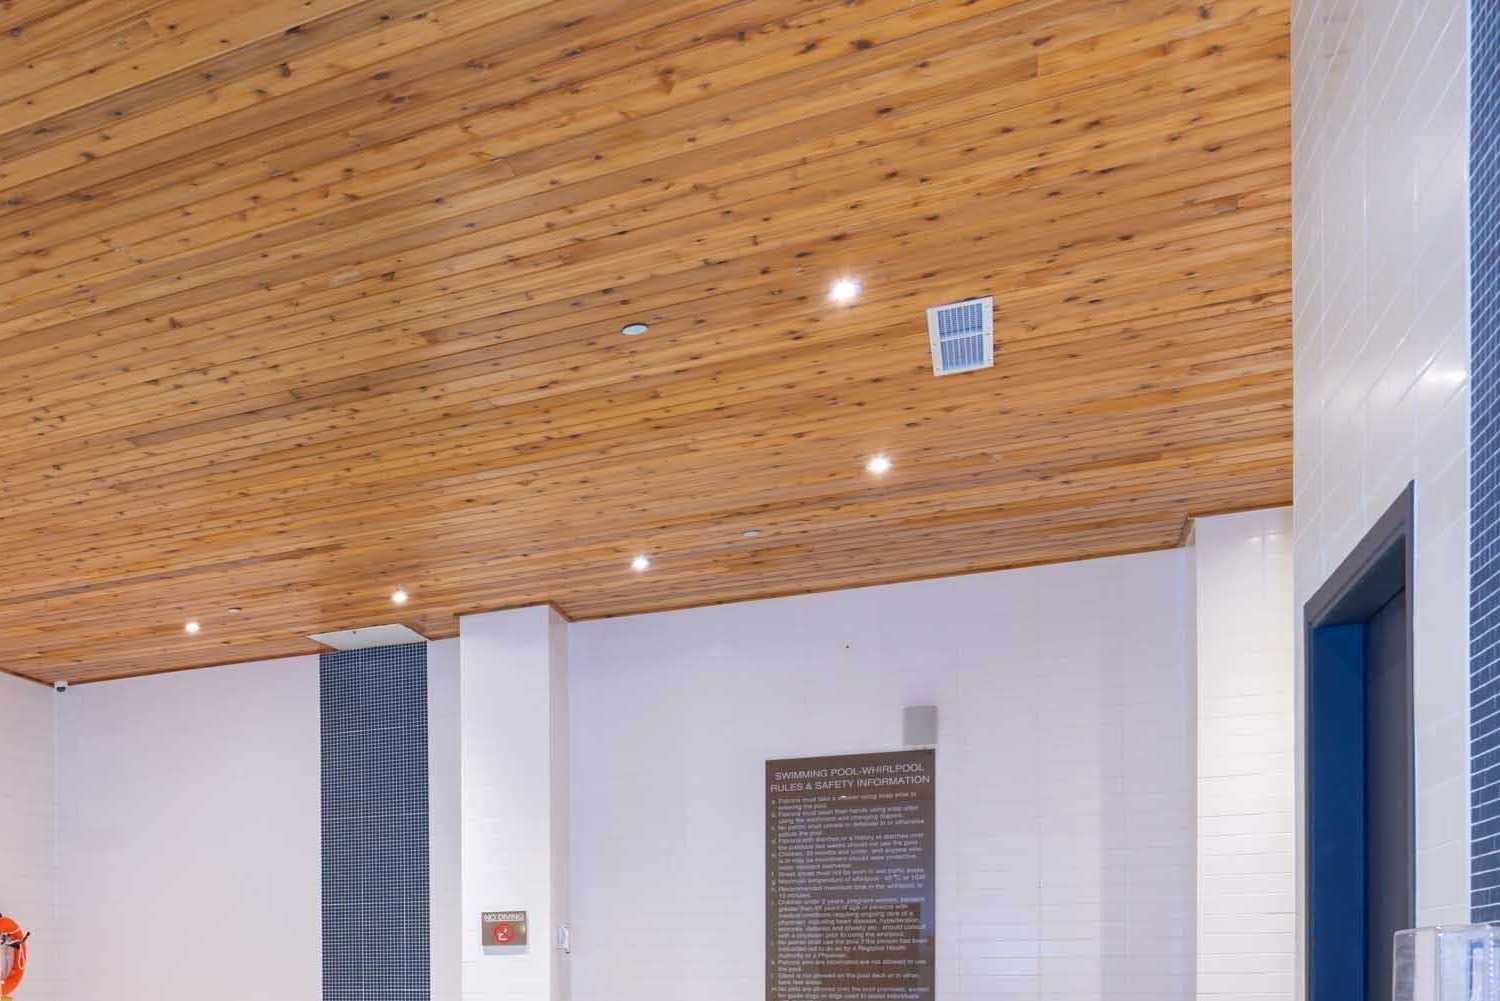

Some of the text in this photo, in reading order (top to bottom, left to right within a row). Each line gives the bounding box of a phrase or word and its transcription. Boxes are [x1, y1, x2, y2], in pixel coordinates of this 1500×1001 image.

[774, 769, 828, 780] SWIMMING
[770, 782, 803, 793] RULES
[814, 779, 854, 790] SAFETY
[857, 775, 931, 788] INFORMATION
